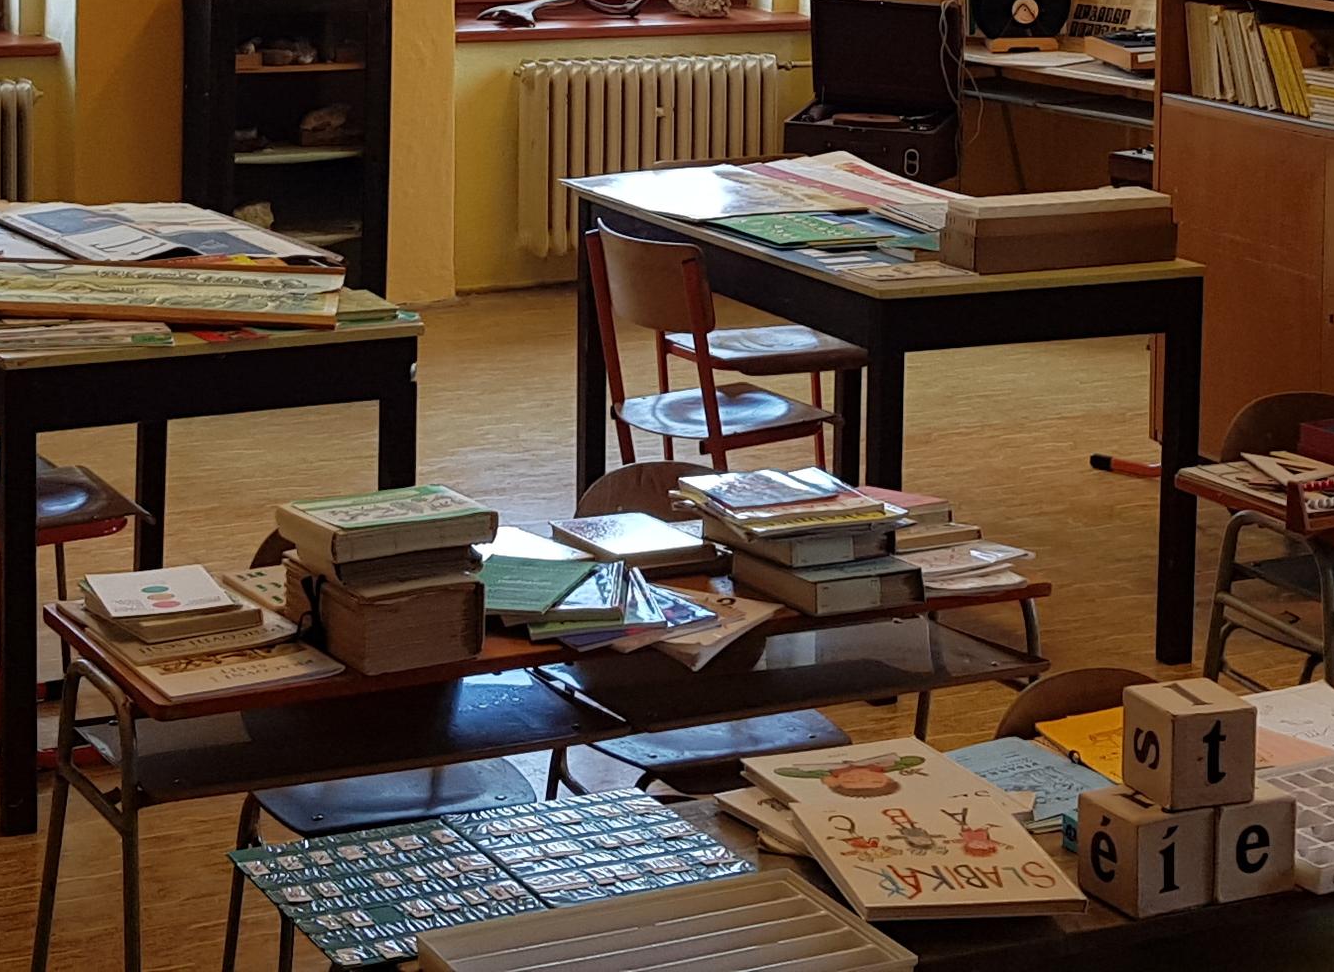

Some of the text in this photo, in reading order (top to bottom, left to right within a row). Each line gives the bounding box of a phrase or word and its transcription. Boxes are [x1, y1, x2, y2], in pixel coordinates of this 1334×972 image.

[1203, 720, 1226, 784] t
[941, 807, 969, 826] A
[1091, 815, 1180, 894] é í
[1236, 825, 1270, 874] e
